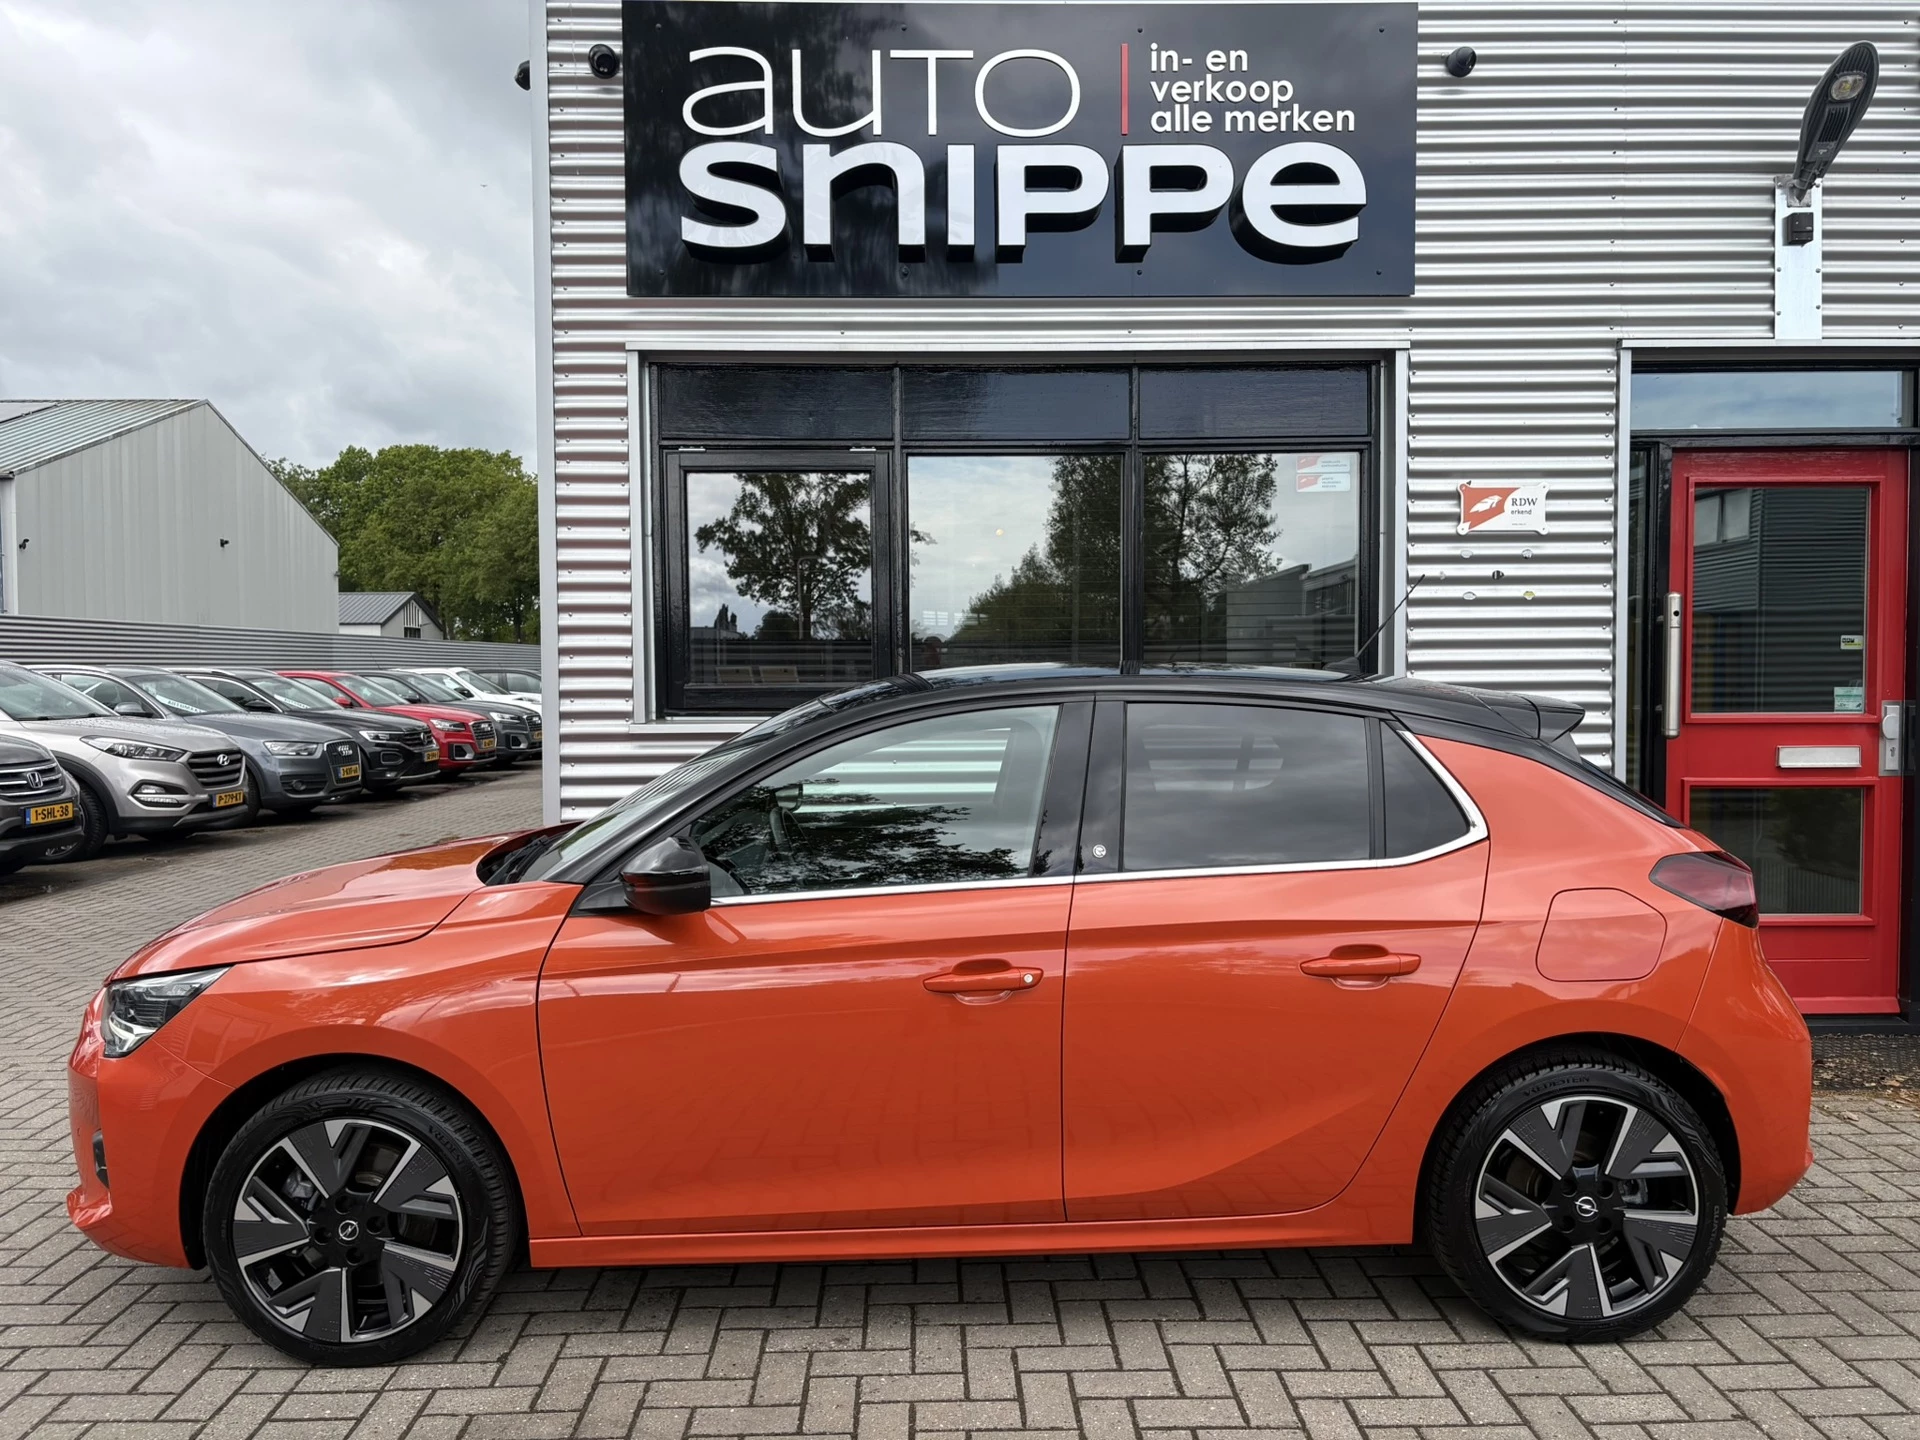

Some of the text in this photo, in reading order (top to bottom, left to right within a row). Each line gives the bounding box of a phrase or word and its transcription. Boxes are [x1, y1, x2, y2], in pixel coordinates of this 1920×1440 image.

[1151, 43, 1247, 71] in- en
[1150, 73, 1294, 109] verkoop
[1150, 103, 1355, 133] alle merken
[1511, 497, 1538, 507] RDW
[35, 805, 69, 821] 1-SHL-38
